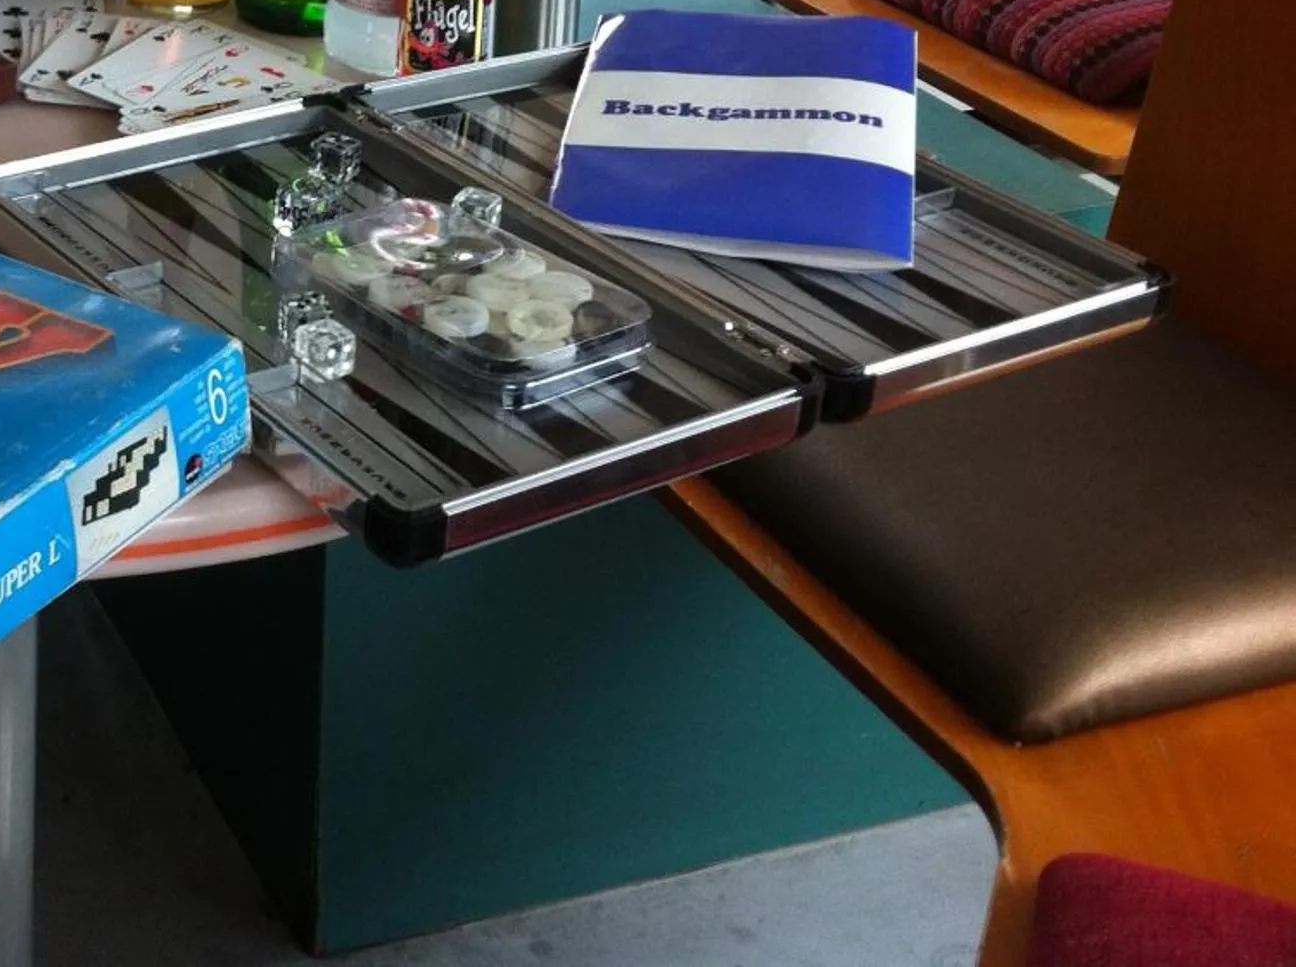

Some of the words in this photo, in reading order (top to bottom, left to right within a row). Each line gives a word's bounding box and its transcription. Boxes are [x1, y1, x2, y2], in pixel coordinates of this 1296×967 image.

[600, 99, 884, 128] Backgammon
[207, 368, 228, 426] 6
[48, 538, 62, 566] L
